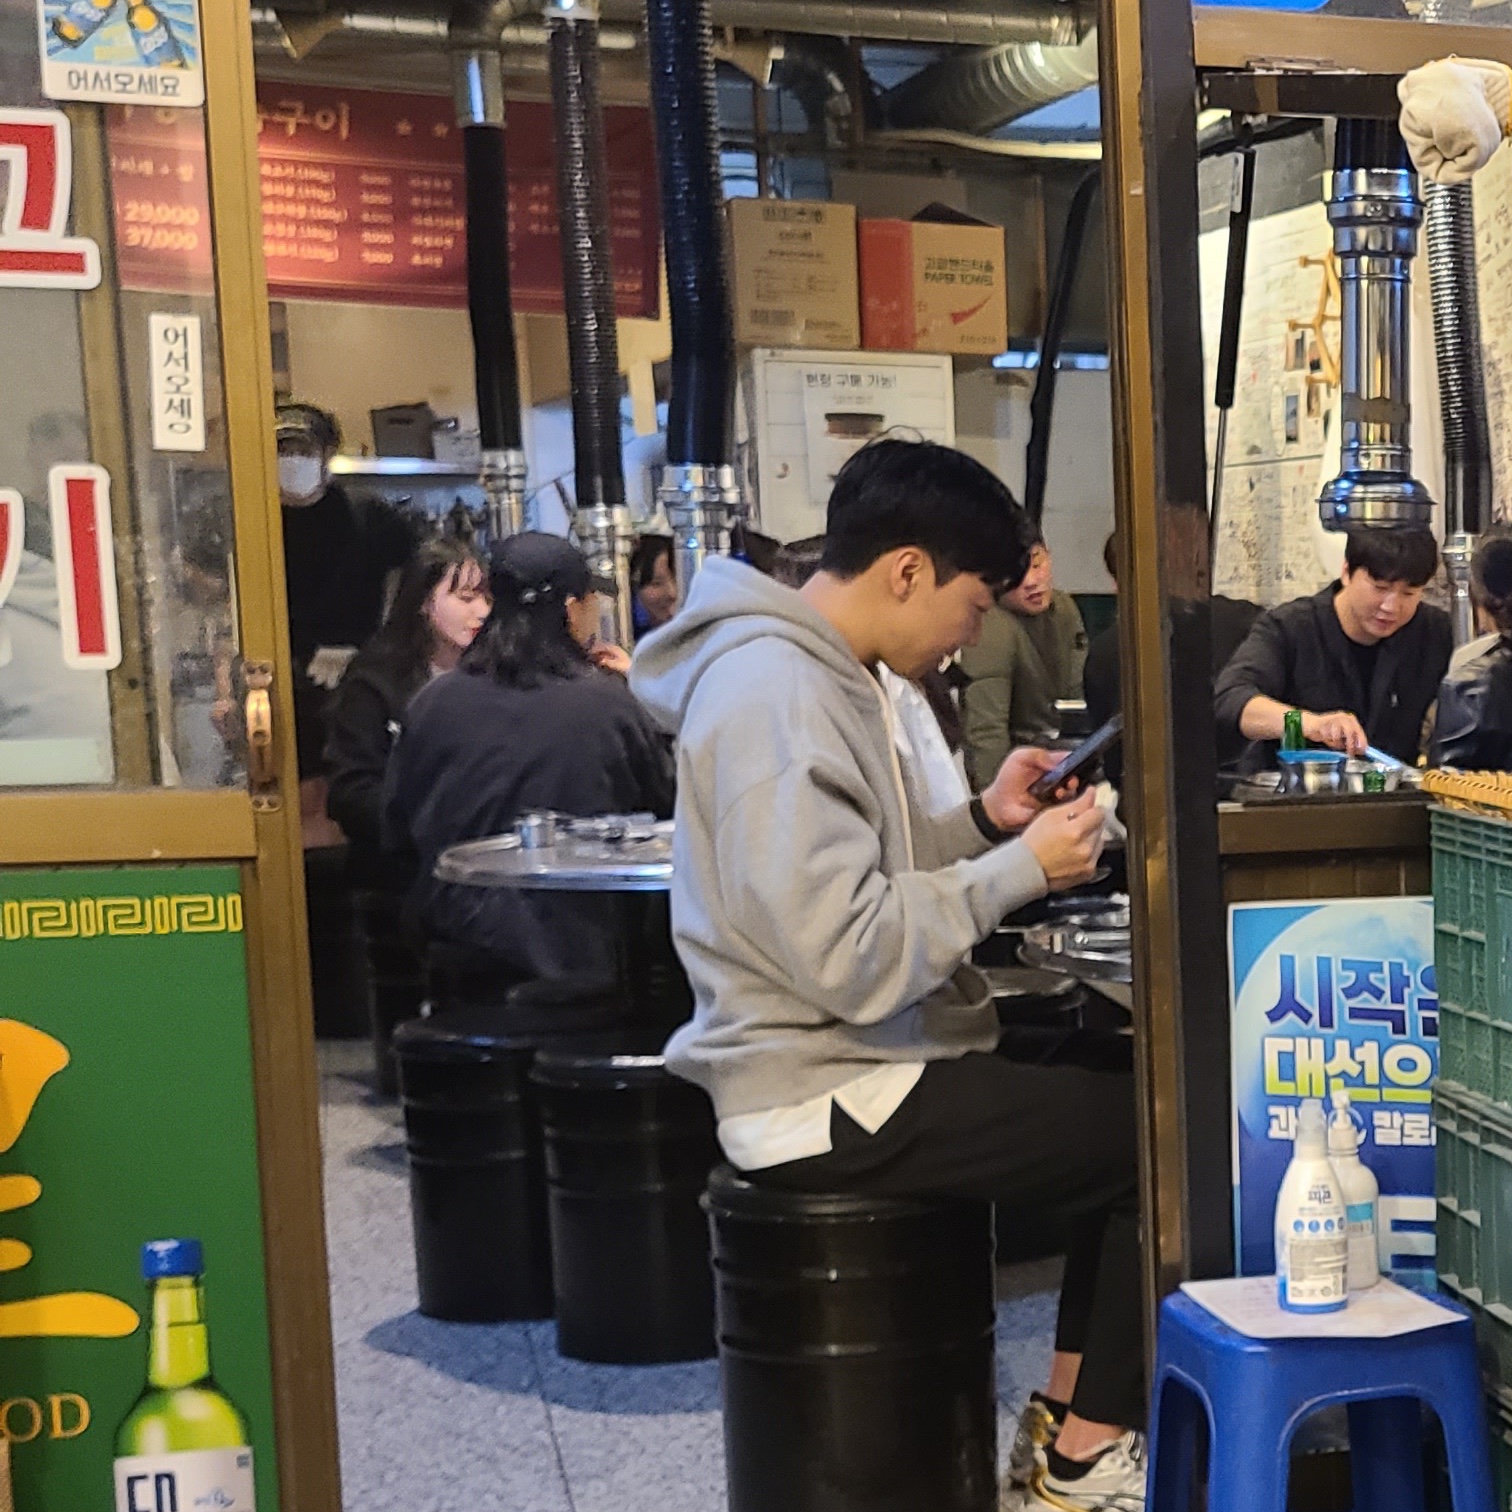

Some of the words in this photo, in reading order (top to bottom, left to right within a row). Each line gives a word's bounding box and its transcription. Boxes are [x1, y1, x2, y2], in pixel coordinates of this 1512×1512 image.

[68, 69, 181, 98] 어서오세요
[1263, 1037, 1438, 1103] 대선으
[1373, 1111, 1438, 1147] 칼로
